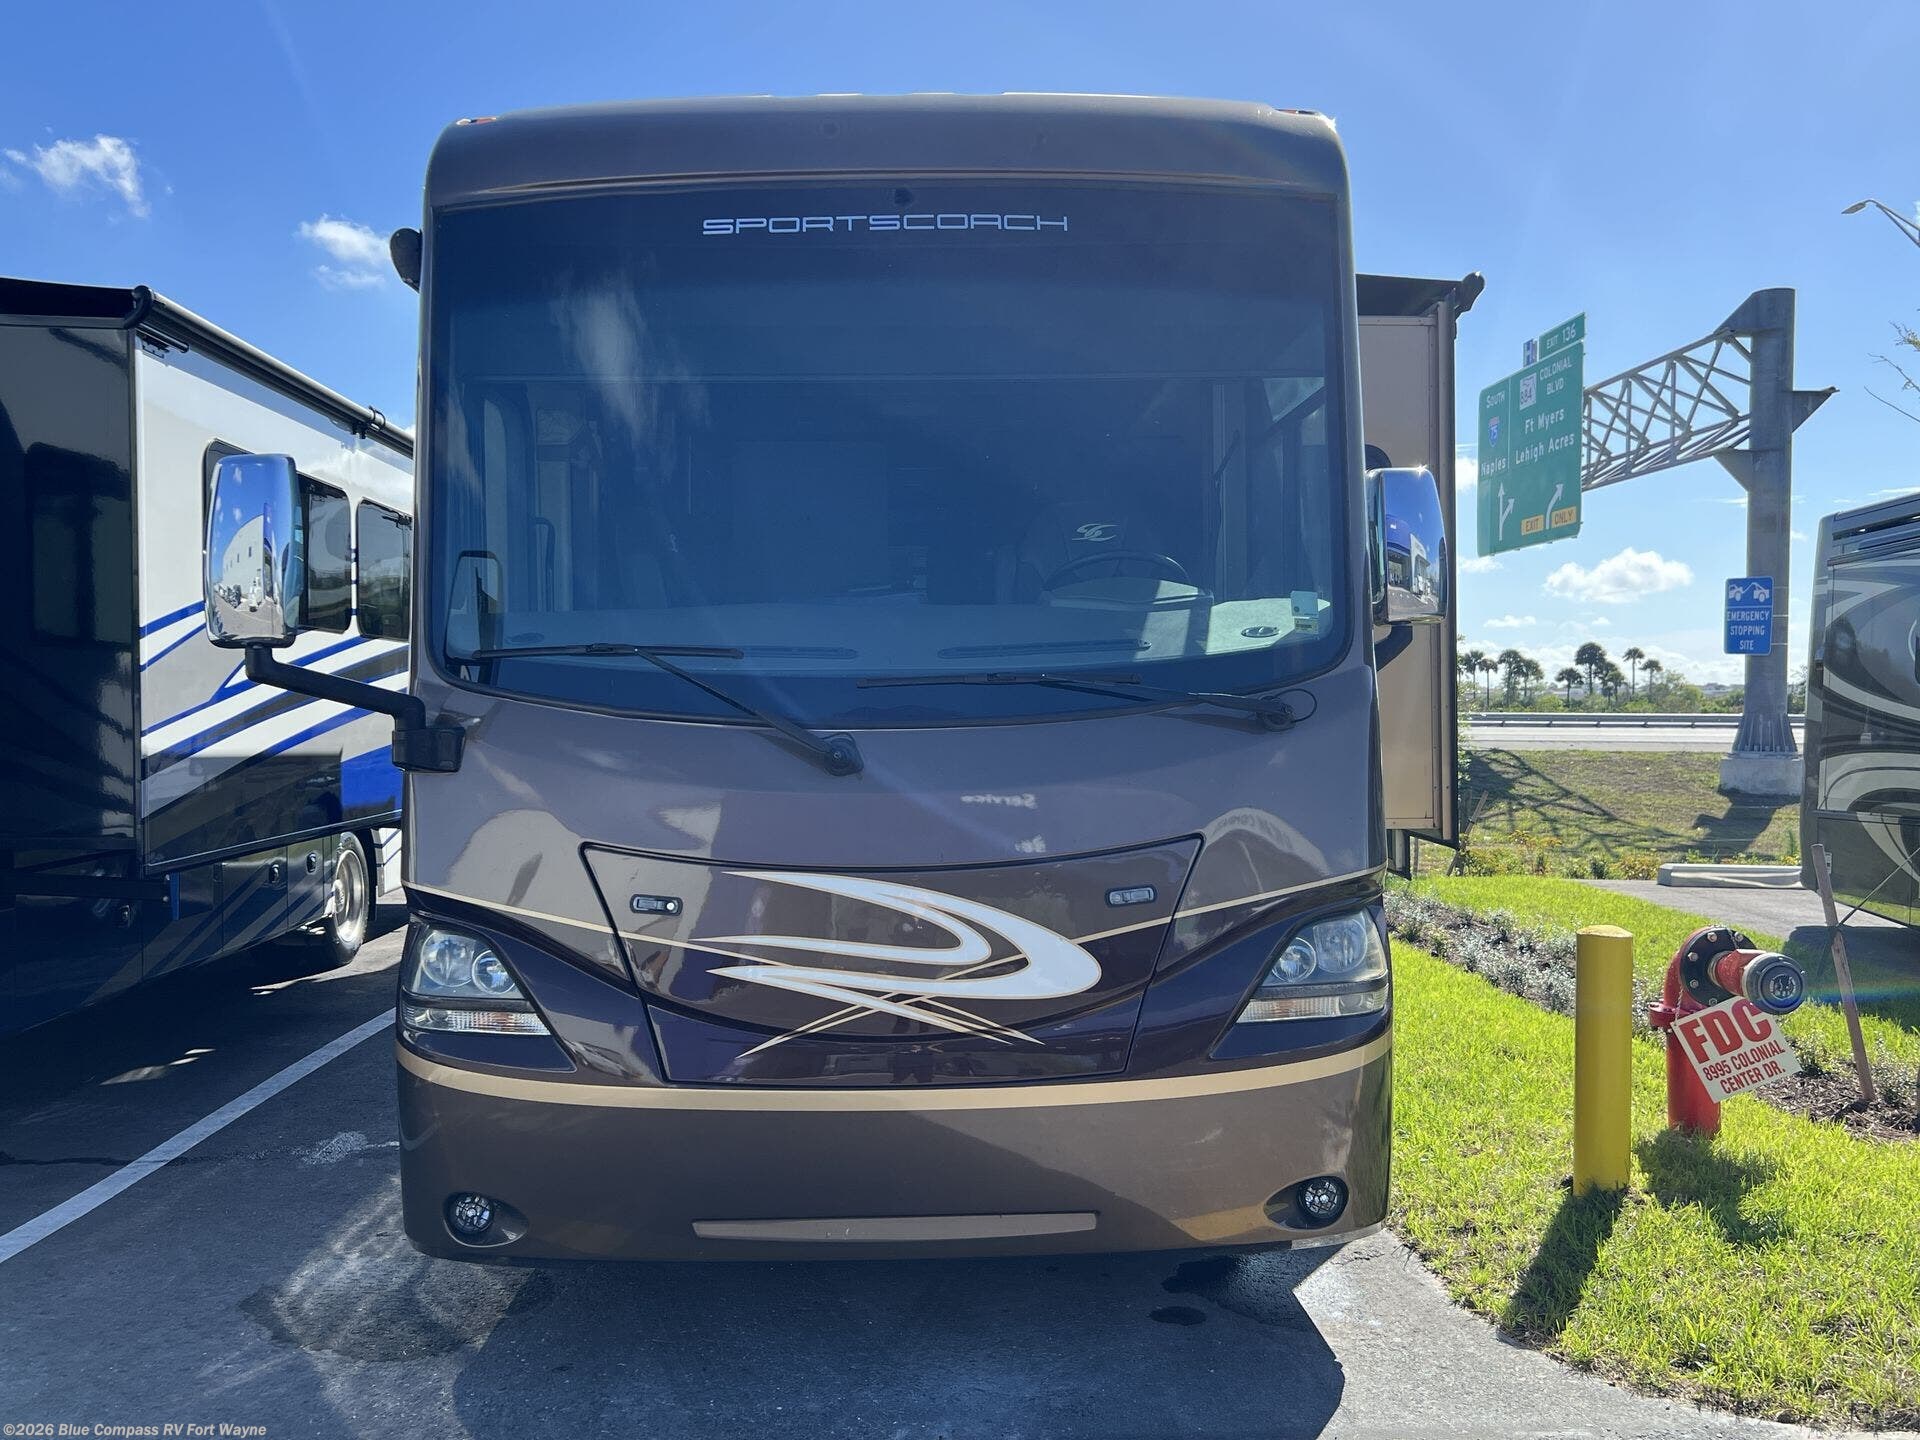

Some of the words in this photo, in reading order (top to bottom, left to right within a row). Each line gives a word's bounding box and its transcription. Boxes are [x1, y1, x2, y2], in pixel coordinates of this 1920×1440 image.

[702, 213, 1069, 236] SPORTSCOACH
[1546, 334, 1559, 350] EXIT
[1562, 322, 1577, 343] 136
[1539, 356, 1573, 381] COLONIAL
[1546, 377, 1565, 395] BLVD
[1486, 390, 1505, 409] SOUTH
[1524, 417, 1535, 435] Ft
[1537, 408, 1565, 431] Myers
[1515, 442, 1545, 465] Lehigh
[1547, 433, 1575, 454] Acres
[1480, 457, 1507, 477] Naples
[1525, 517, 1541, 533] EXIT
[1554, 509, 1575, 526] ONLY
[1727, 610, 1770, 621] EMERGENCY
[1729, 625, 1766, 636] STOPPING
[1739, 640, 1755, 651] SITE
[1678, 998, 1773, 1065] FDC
[1702, 1061, 1732, 1082] 8995
[1731, 1039, 1786, 1070] COLONIAL
[1719, 1070, 1765, 1095] CENTER
[1764, 1060, 1787, 1079] DR.
